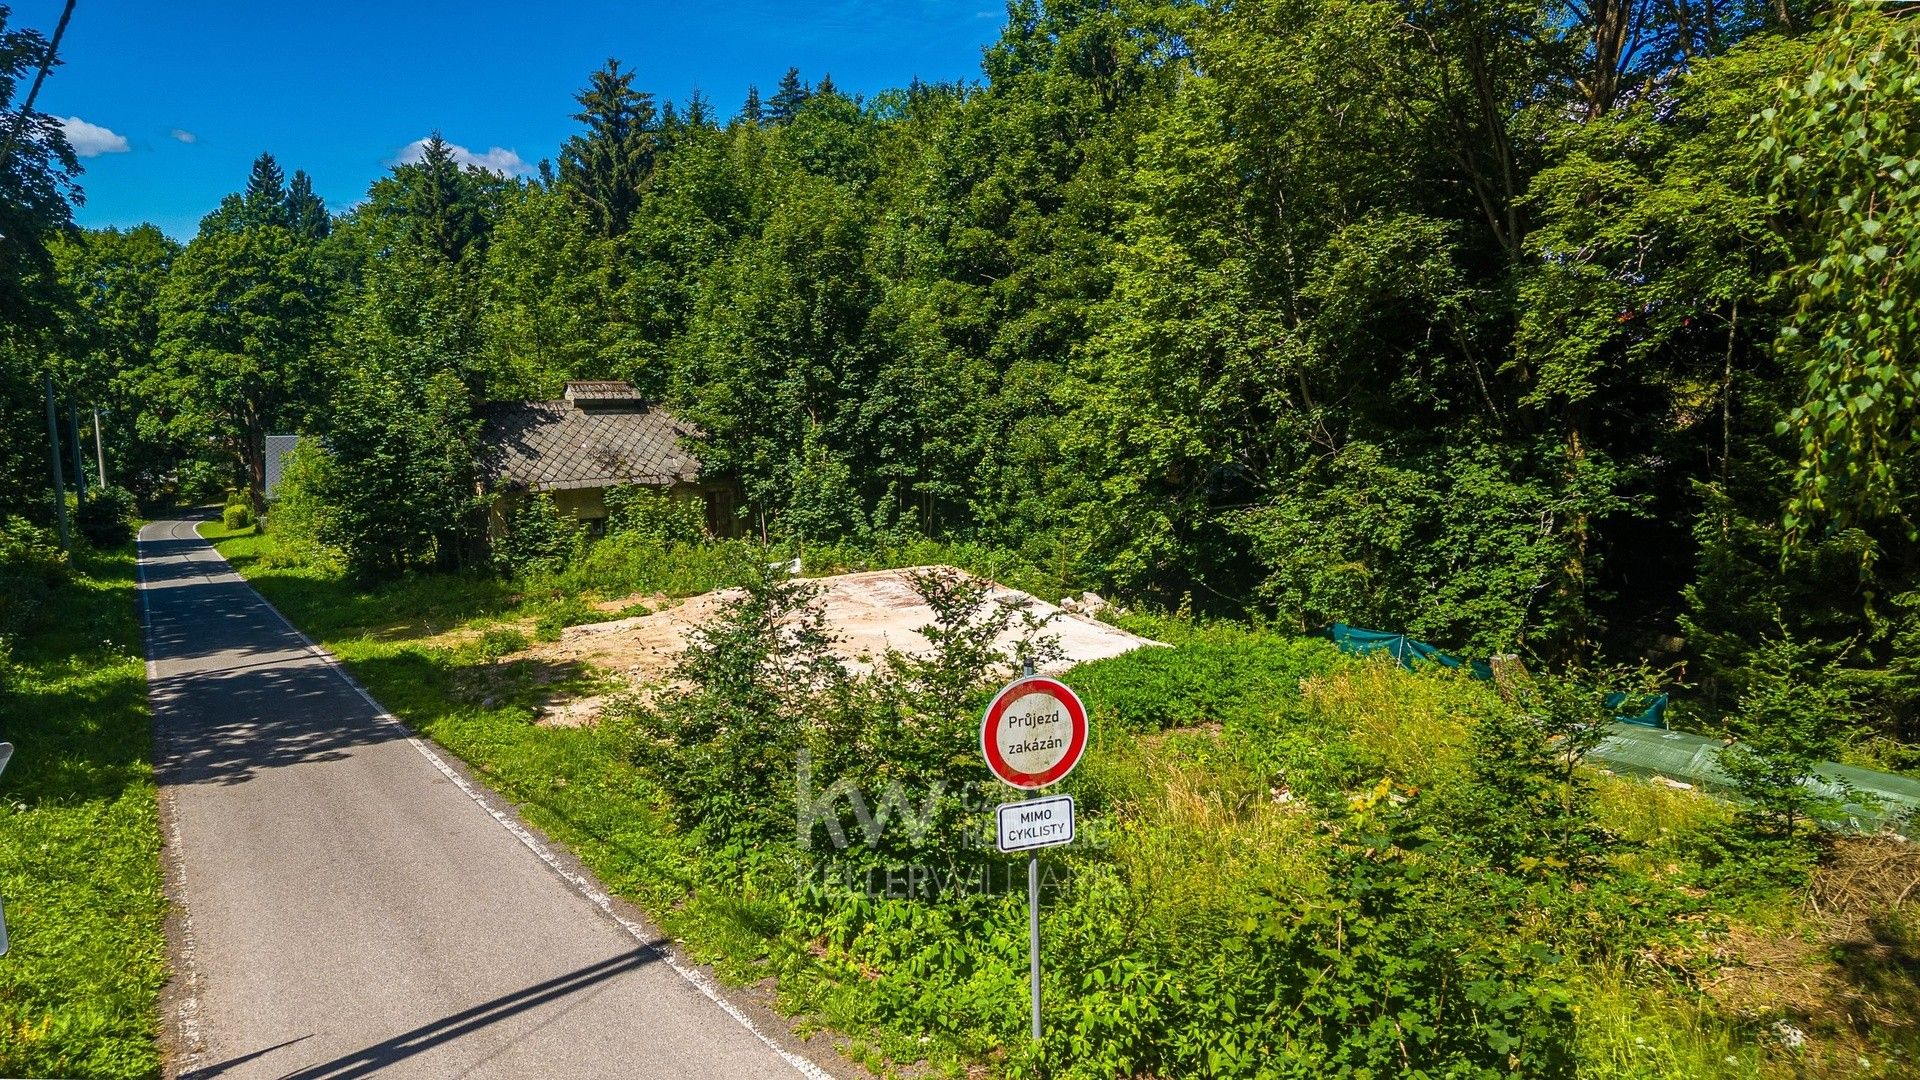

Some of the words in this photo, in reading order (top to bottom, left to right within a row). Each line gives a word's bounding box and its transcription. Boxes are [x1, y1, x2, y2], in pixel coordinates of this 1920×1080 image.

[1008, 710, 1060, 729] Průjezd
[1008, 735, 1063, 755] zakázán
[1020, 809, 1052, 825] MIMO
[1008, 823, 1065, 842] CYKLISTY
